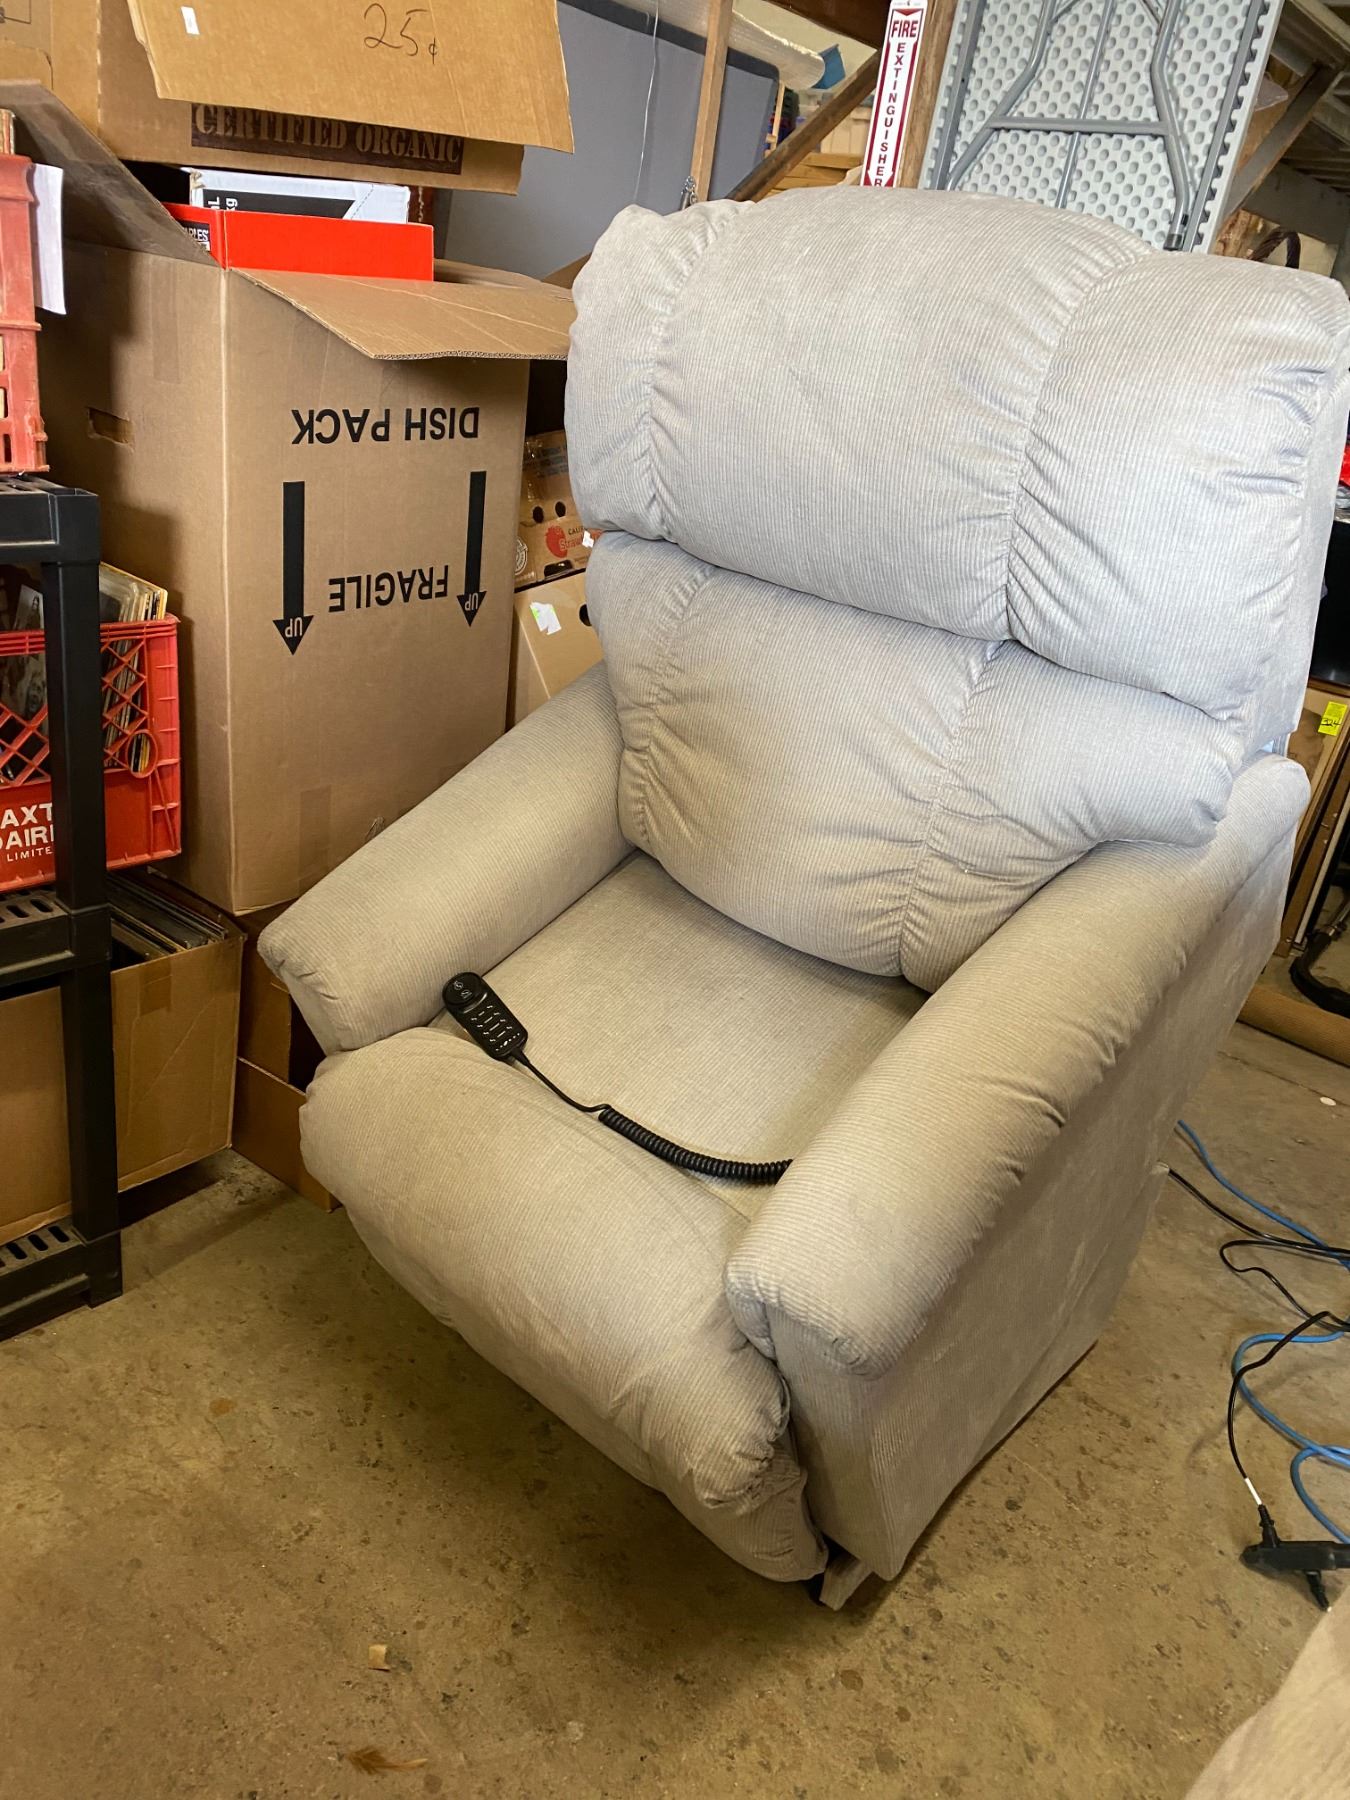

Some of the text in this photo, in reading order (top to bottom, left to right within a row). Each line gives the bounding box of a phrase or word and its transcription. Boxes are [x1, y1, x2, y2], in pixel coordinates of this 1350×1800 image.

[891, 20, 918, 38] FIRE
[195, 105, 460, 162] CERTIFIED ORGANIC
[291, 407, 480, 444] DISH PACK
[328, 565, 449, 613] FRAGILE
[463, 592, 479, 611] UP
[285, 617, 303, 638] UP
